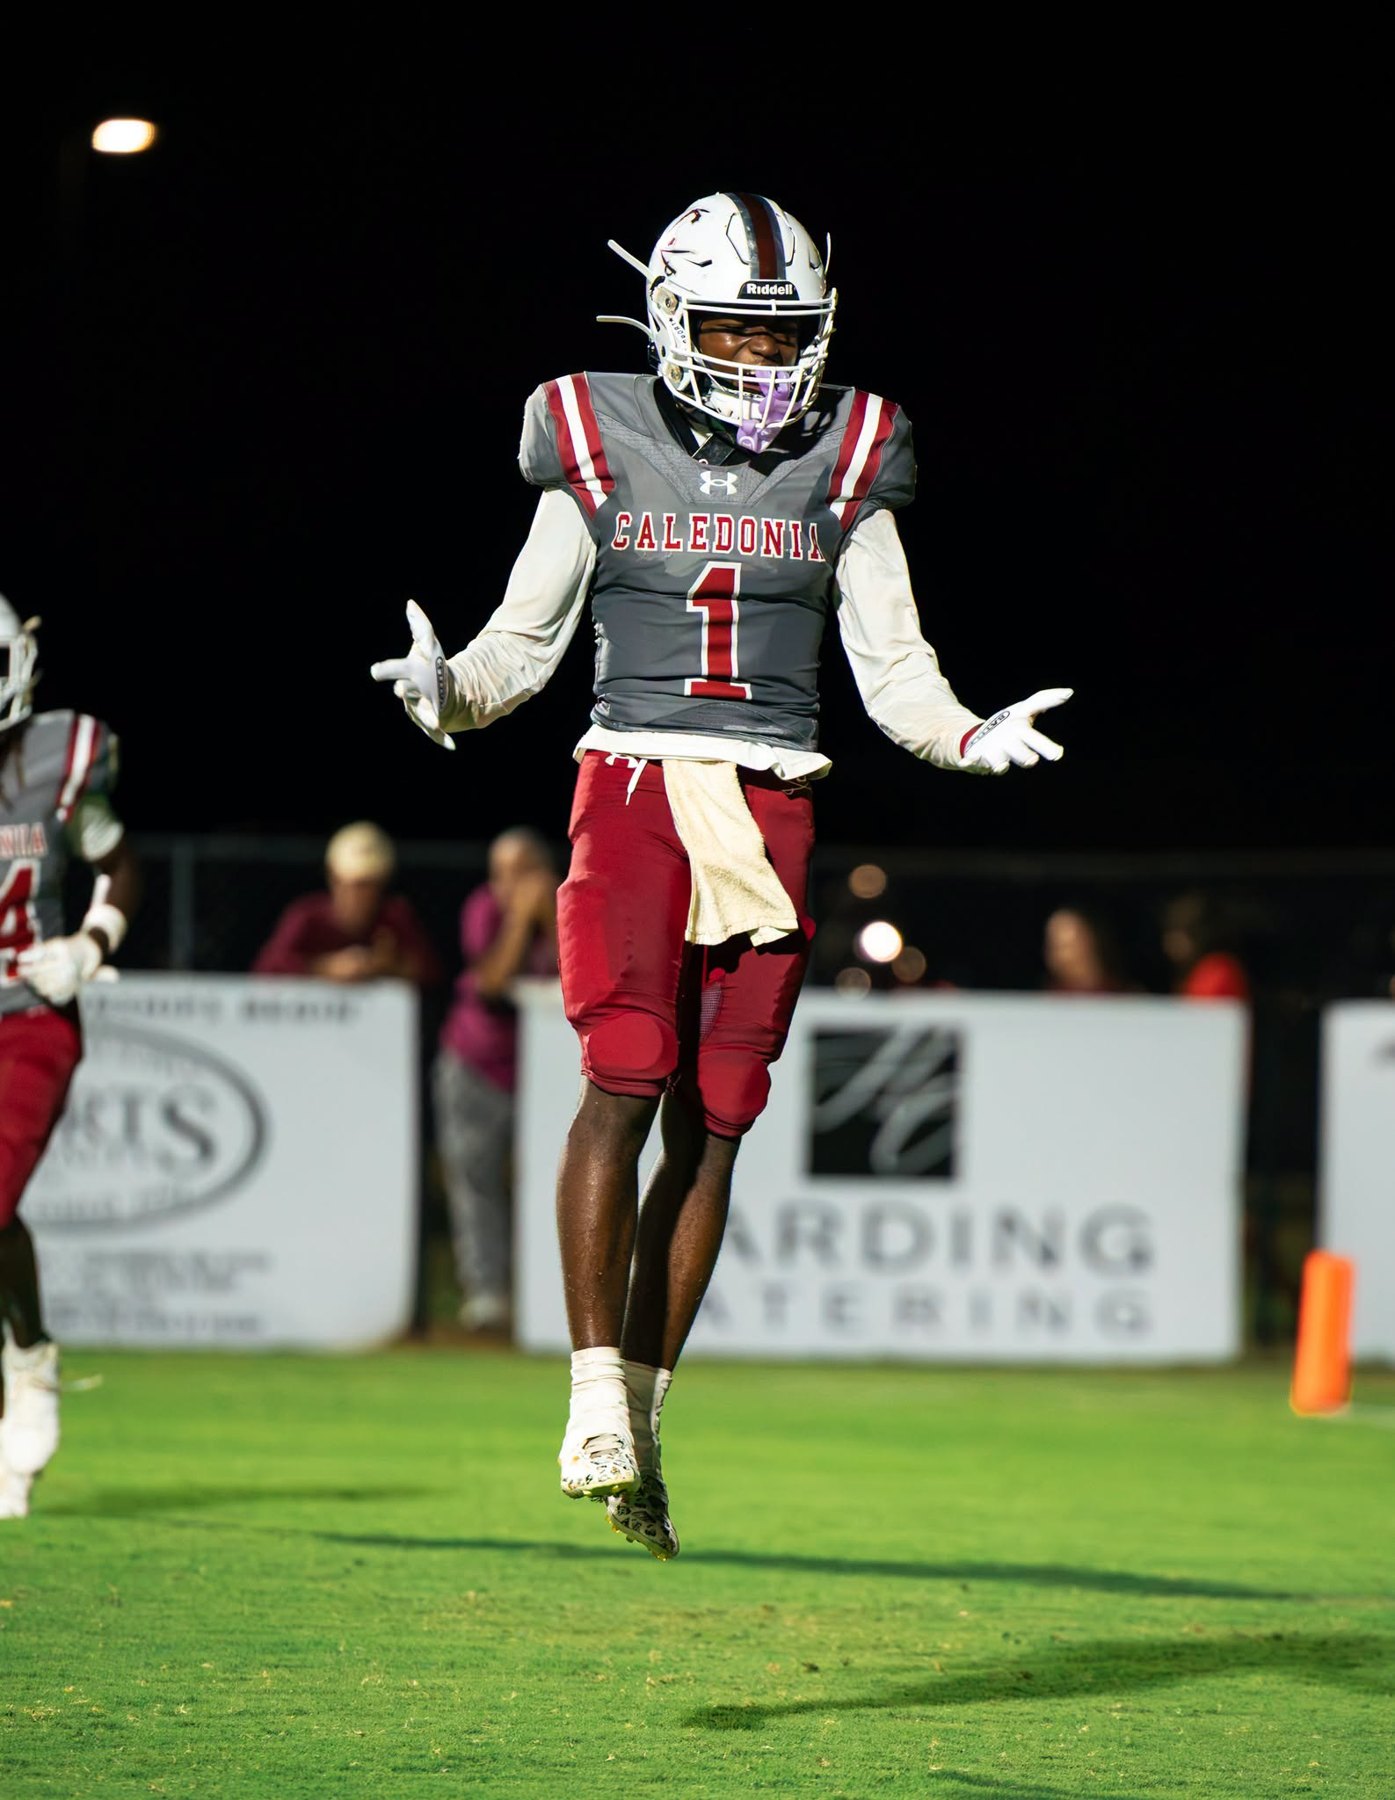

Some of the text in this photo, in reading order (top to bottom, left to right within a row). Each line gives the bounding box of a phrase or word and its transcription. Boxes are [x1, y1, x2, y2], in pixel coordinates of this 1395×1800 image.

[746, 283, 793, 296] Riddell
[611, 511, 826, 562] CALEDONIA
[684, 561, 752, 700] 1
[55, 1083, 218, 1177] RTS
[718, 1200, 1153, 1276] ARDING
[693, 1280, 1152, 1337] ATERING
